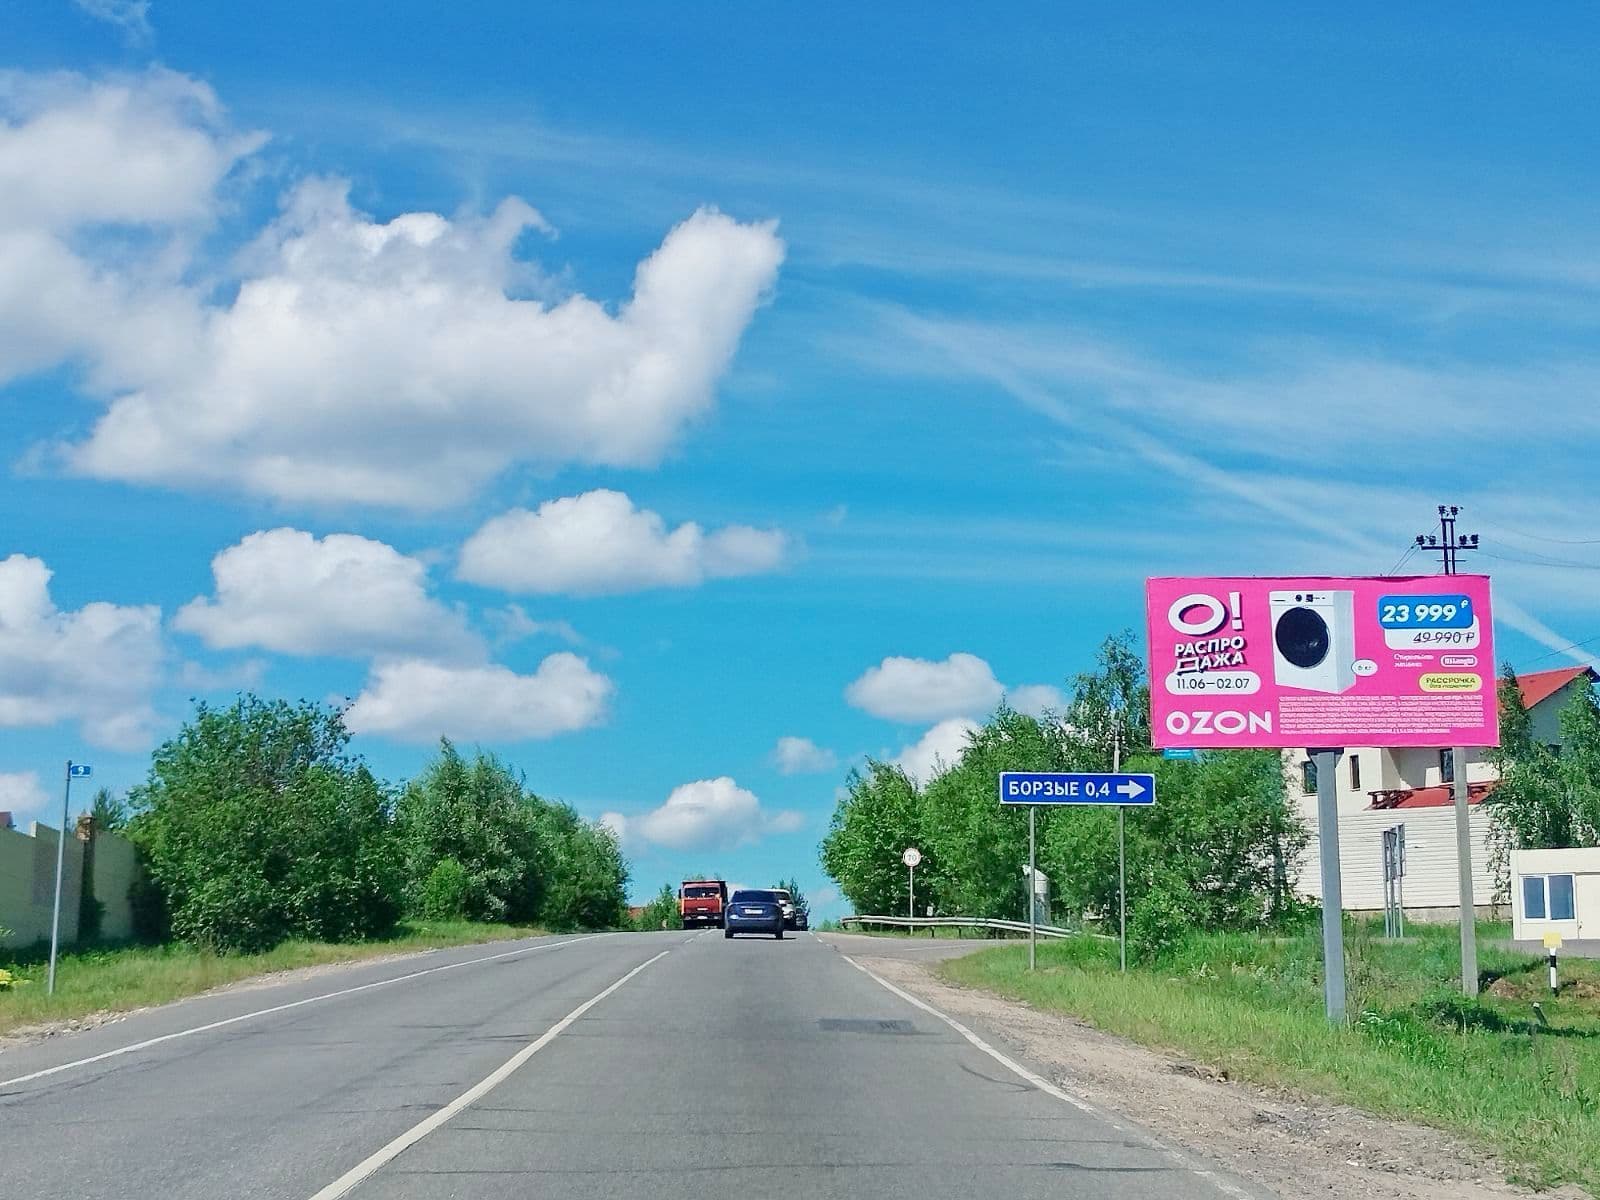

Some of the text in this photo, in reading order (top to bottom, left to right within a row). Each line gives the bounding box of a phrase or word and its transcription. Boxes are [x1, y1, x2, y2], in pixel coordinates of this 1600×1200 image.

[1381, 604, 1410, 623] 23
[1415, 604, 1457, 622] 999
[1174, 635, 1245, 657] РАСПРО
[1413, 631, 1431, 644] 49
[1435, 631, 1461, 644] 990
[1175, 651, 1245, 673] ДАЖА
[1166, 711, 1273, 735] OZON
[1008, 781, 1110, 798] БОРЗЫЕ 0,4
